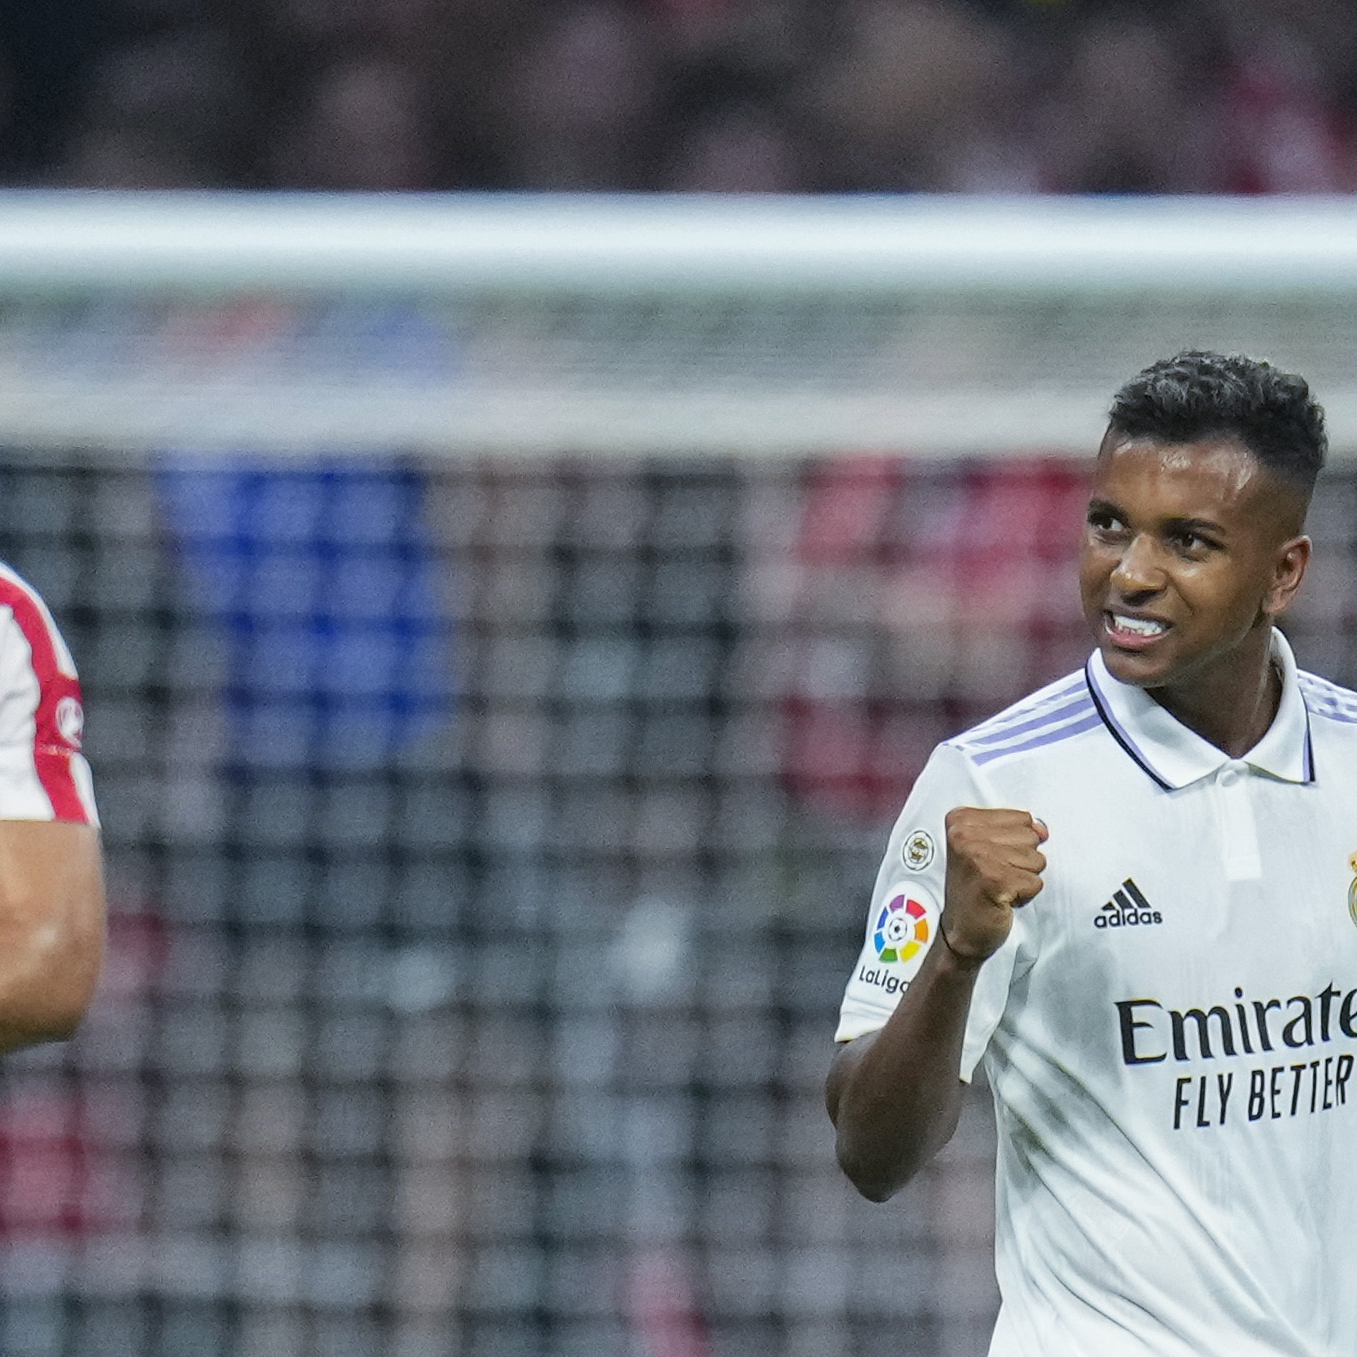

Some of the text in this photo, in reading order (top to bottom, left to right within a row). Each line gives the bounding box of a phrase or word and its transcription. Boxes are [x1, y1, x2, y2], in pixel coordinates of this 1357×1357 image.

[1093, 907, 1164, 930] adidas
[1173, 1054, 1355, 1130] FLY BETTER
